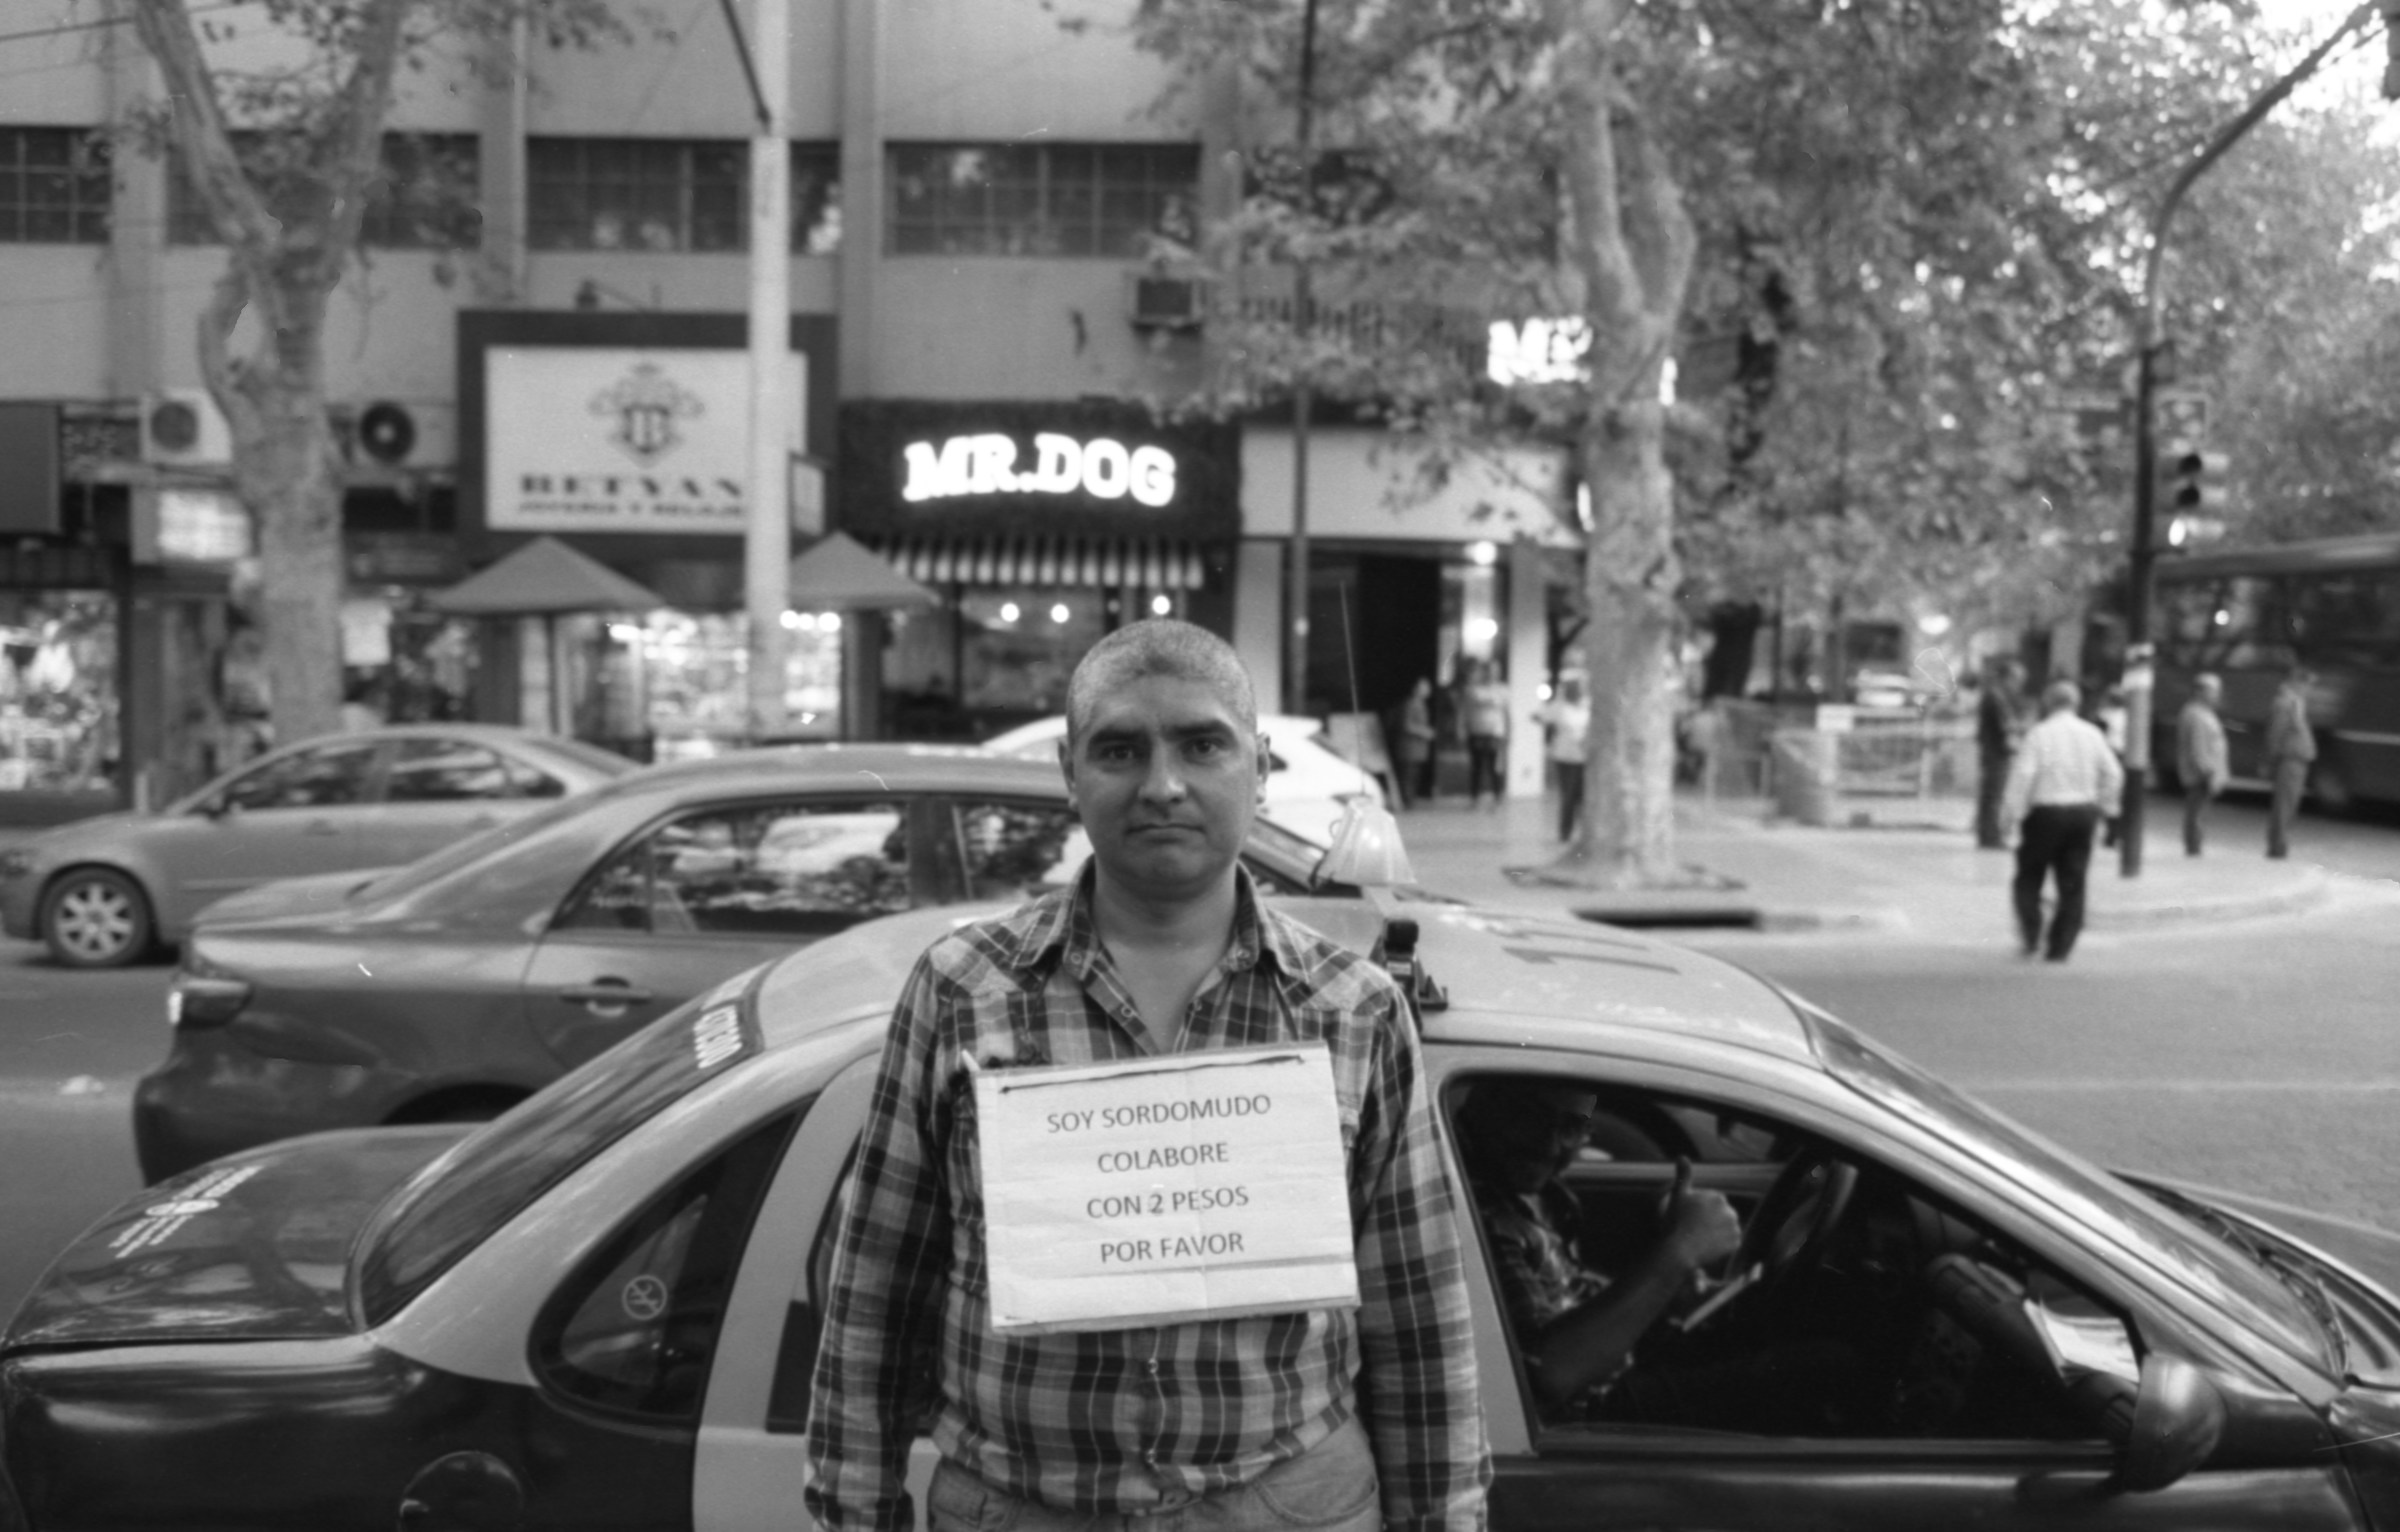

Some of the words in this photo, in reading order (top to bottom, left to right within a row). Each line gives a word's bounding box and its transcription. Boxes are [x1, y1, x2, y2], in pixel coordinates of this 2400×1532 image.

[902, 432, 1177, 507] MR.DOG
[1047, 1110, 1095, 1134] SOY
[1101, 1094, 1272, 1129] SORDOMUDO
[1097, 1142, 1229, 1174] COLABORE
[1086, 1192, 1142, 1219] CON
[1149, 1193, 1164, 1215] 2
[1171, 1186, 1250, 1213] PESOS
[1100, 1240, 1153, 1263] POR
[1160, 1232, 1244, 1259] FAVOR
